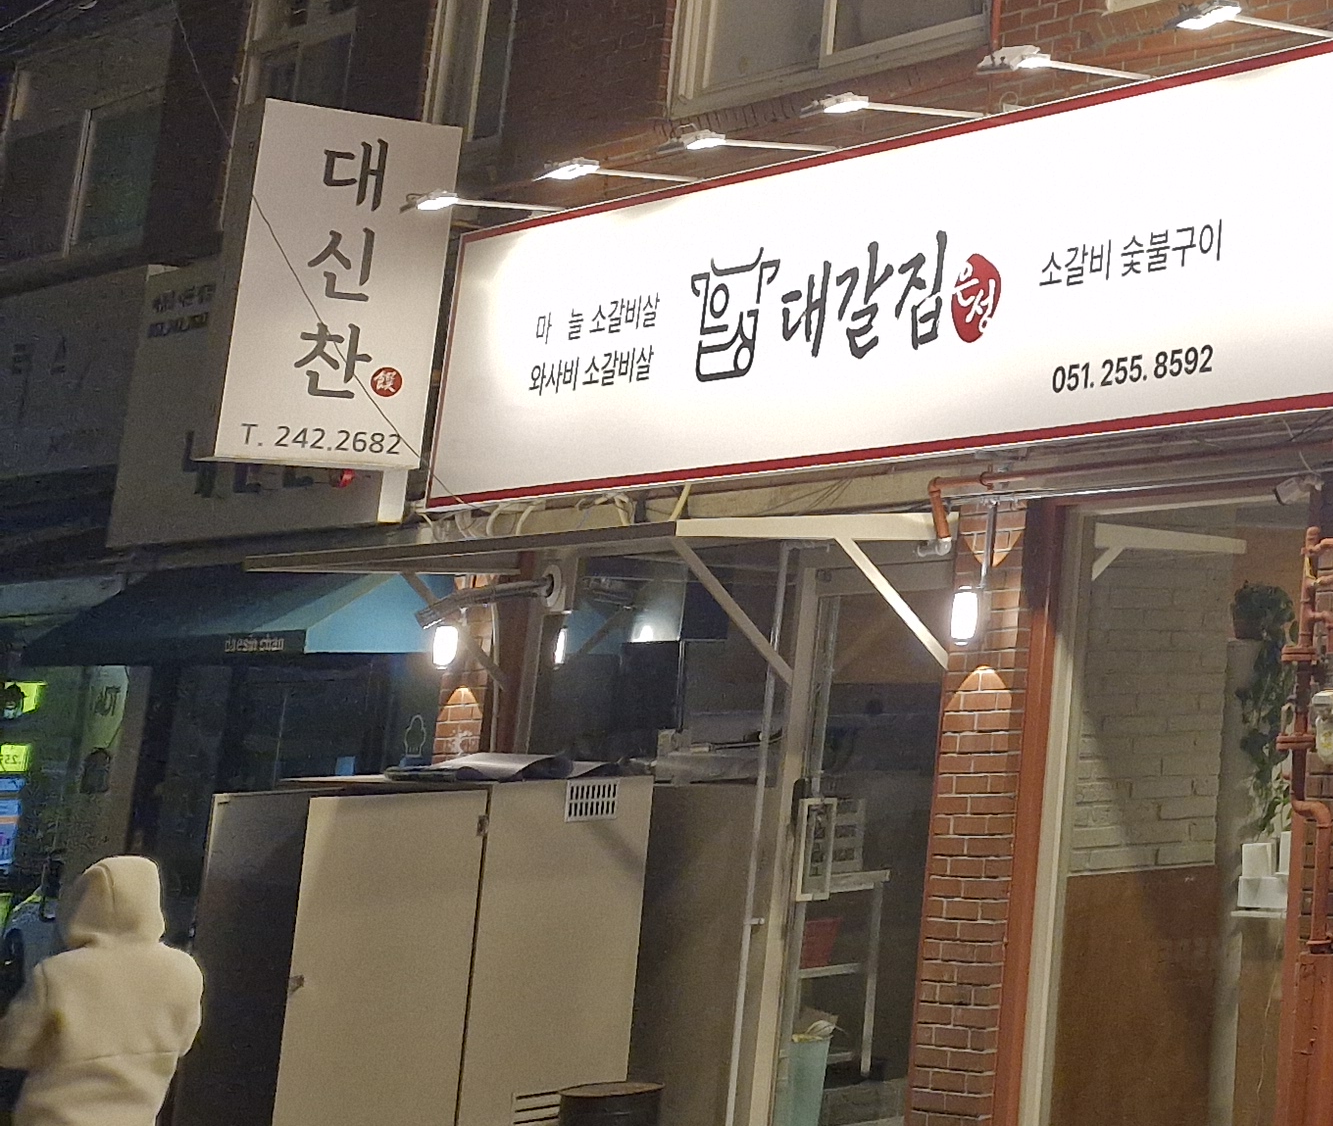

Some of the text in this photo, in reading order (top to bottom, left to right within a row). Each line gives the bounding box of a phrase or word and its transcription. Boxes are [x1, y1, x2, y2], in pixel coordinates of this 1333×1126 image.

[293, 137, 389, 399] 대신찬
[1039, 218, 1222, 287] 소갈비 숯불구이
[589, 292, 661, 334] 소갈비살
[781, 230, 948, 360] 대갈집
[528, 344, 655, 397] 와사비 소갈비살
[274, 425, 402, 455] 242.2682
